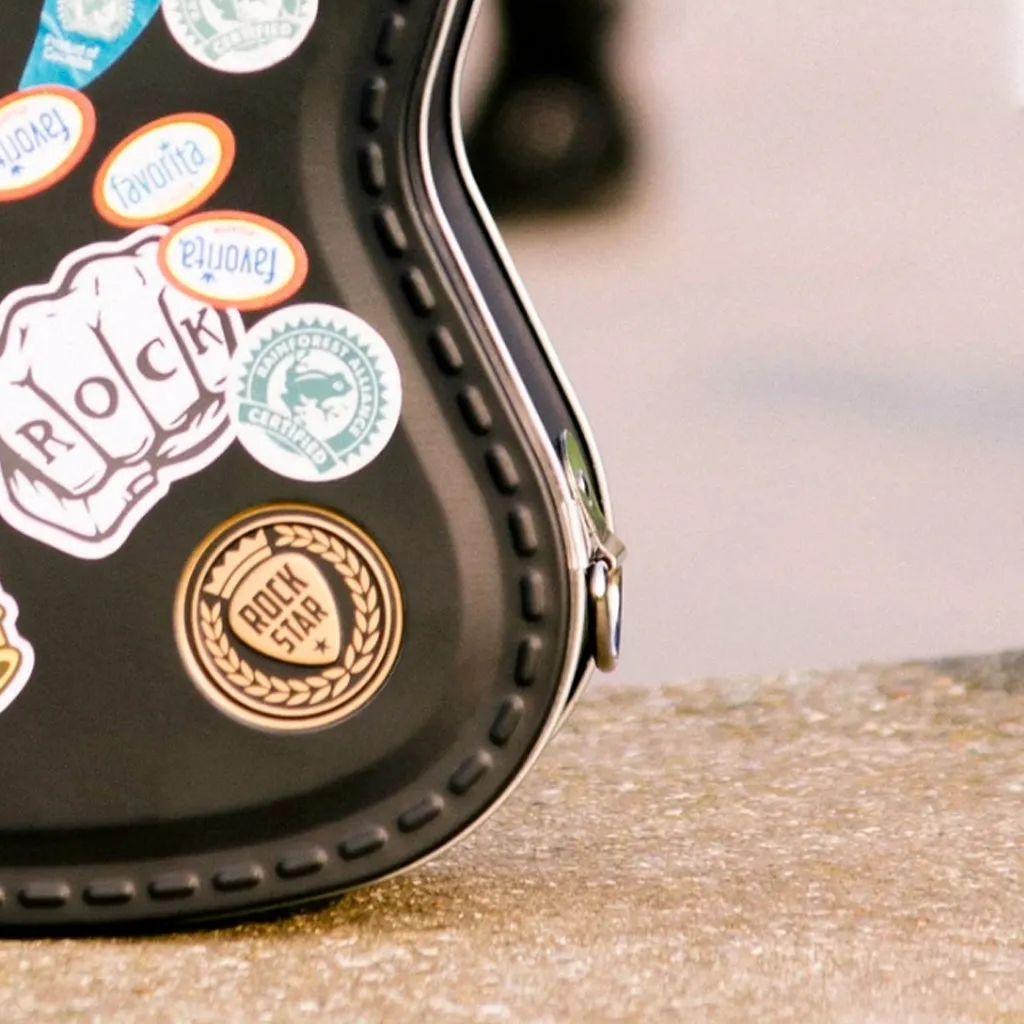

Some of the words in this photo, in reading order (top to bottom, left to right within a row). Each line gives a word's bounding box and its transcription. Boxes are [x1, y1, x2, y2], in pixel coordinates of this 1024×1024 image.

[111, 139, 205, 209] favorita
[179, 235, 276, 284] favorita
[15, 307, 223, 465] ROCK
[257, 334, 349, 378] RAINFOREST
[349, 357, 373, 438] ALLIANCE
[248, 407, 327, 464] CERTIFIED
[238, 562, 309, 635] ROCK
[271, 596, 329, 654] STAR
